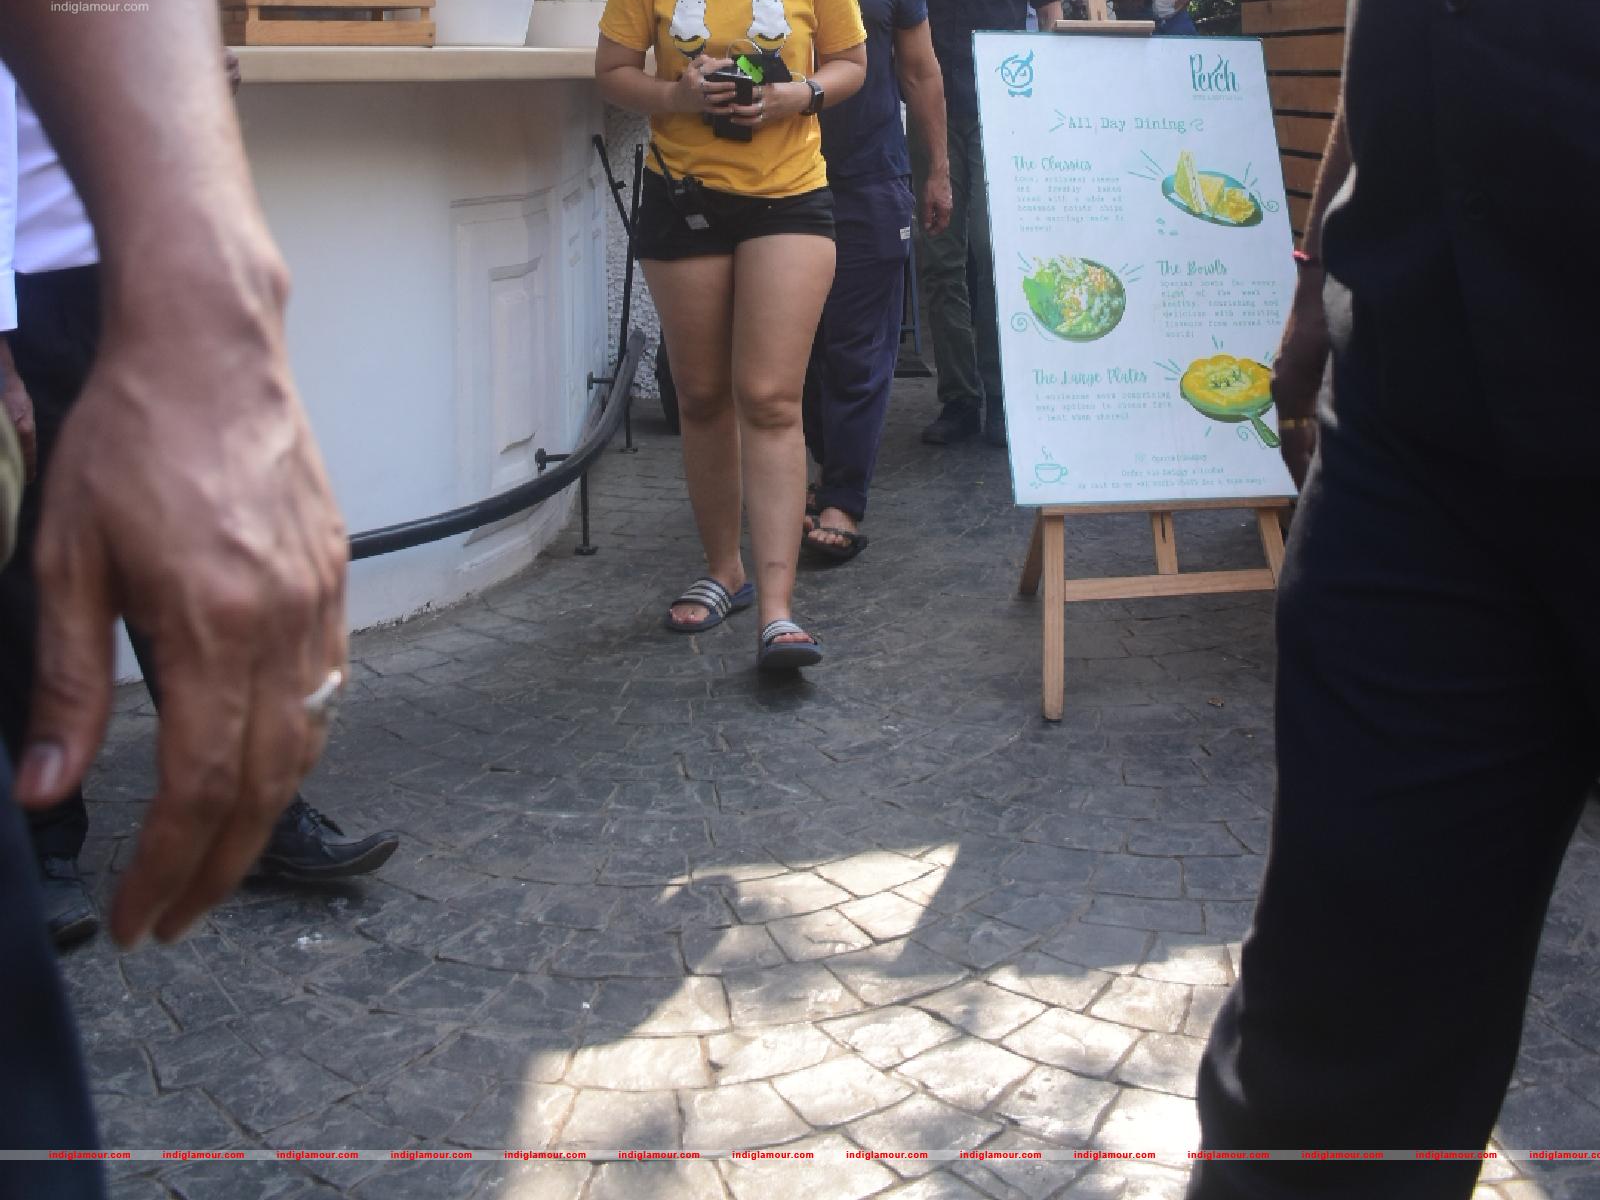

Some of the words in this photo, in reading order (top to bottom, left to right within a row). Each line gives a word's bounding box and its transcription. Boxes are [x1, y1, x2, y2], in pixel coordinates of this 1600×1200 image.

[1190, 54, 1239, 92] Perch
[1068, 116, 1092, 129] All
[1101, 116, 1125, 133] Day
[1135, 116, 1186, 135] Dining
[1155, 259, 1181, 276] The
[1032, 367, 1057, 385] The
[1106, 366, 1148, 385] Plates
